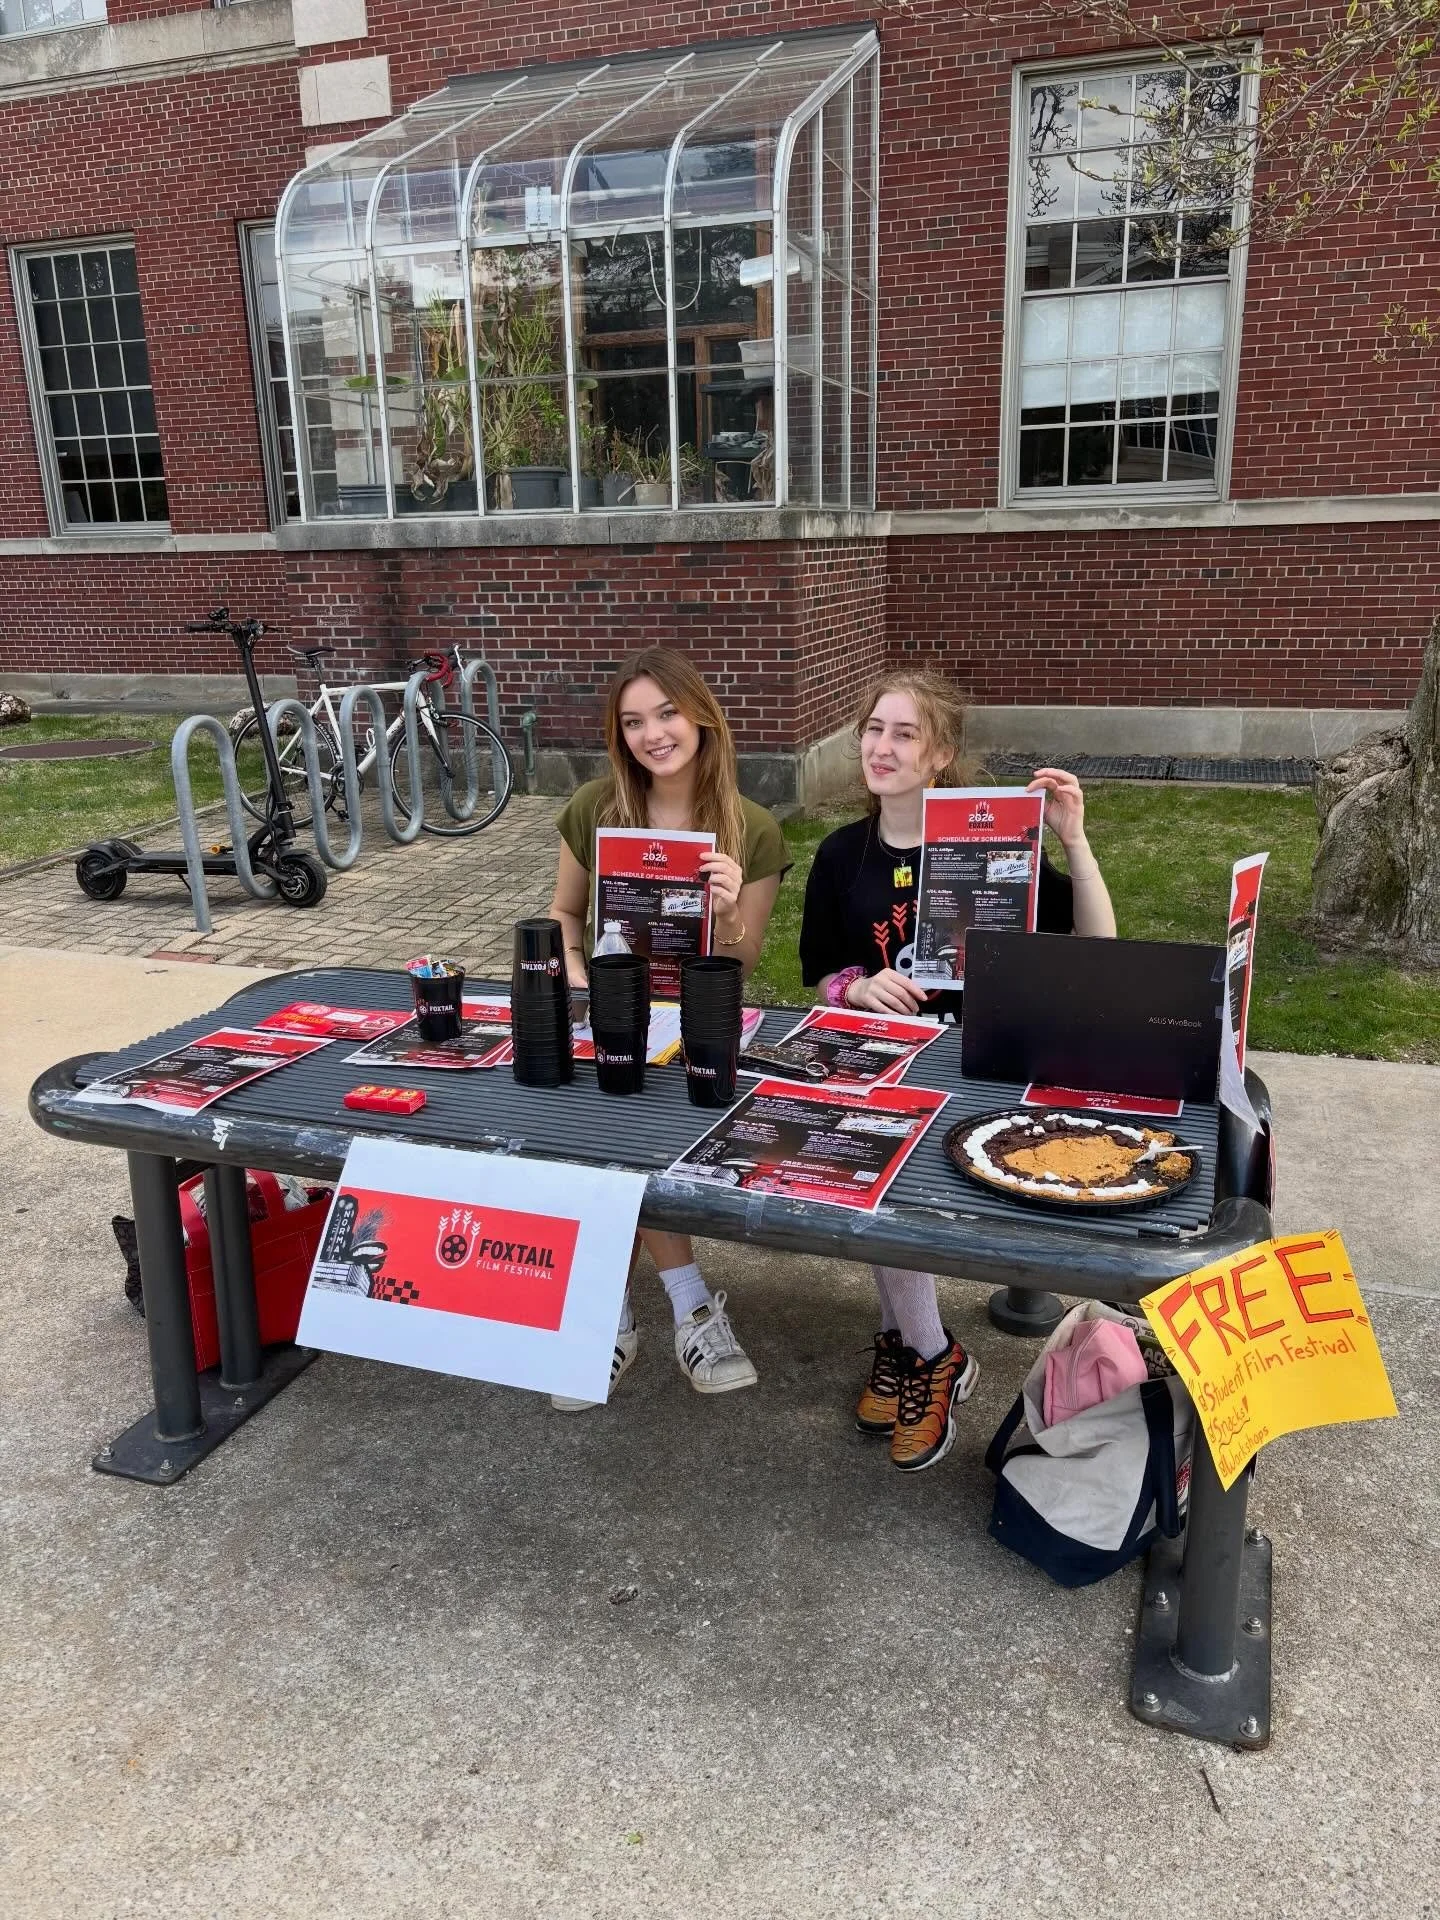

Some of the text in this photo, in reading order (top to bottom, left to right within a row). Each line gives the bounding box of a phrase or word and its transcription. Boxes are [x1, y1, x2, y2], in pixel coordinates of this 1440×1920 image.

[968, 813, 995, 823] 2026
[642, 852, 668, 862] 2026
[612, 870, 645, 879] SCHEDULE
[520, 962, 547, 971] FOXTAIL
[429, 1004, 455, 1012] FOXTAIL
[1148, 1017, 1203, 1028] ASUS VivoBook
[606, 1054, 634, 1062] FOXTAIL
[691, 1065, 717, 1075] FOXTAIL
[478, 1237, 555, 1269] FOXTAIL
[475, 1259, 553, 1280] FILM FESTIVAL
[1157, 1241, 1354, 1377] FREE
[1243, 1349, 1284, 1381] Film
[1280, 1328, 1357, 1363] Festival
